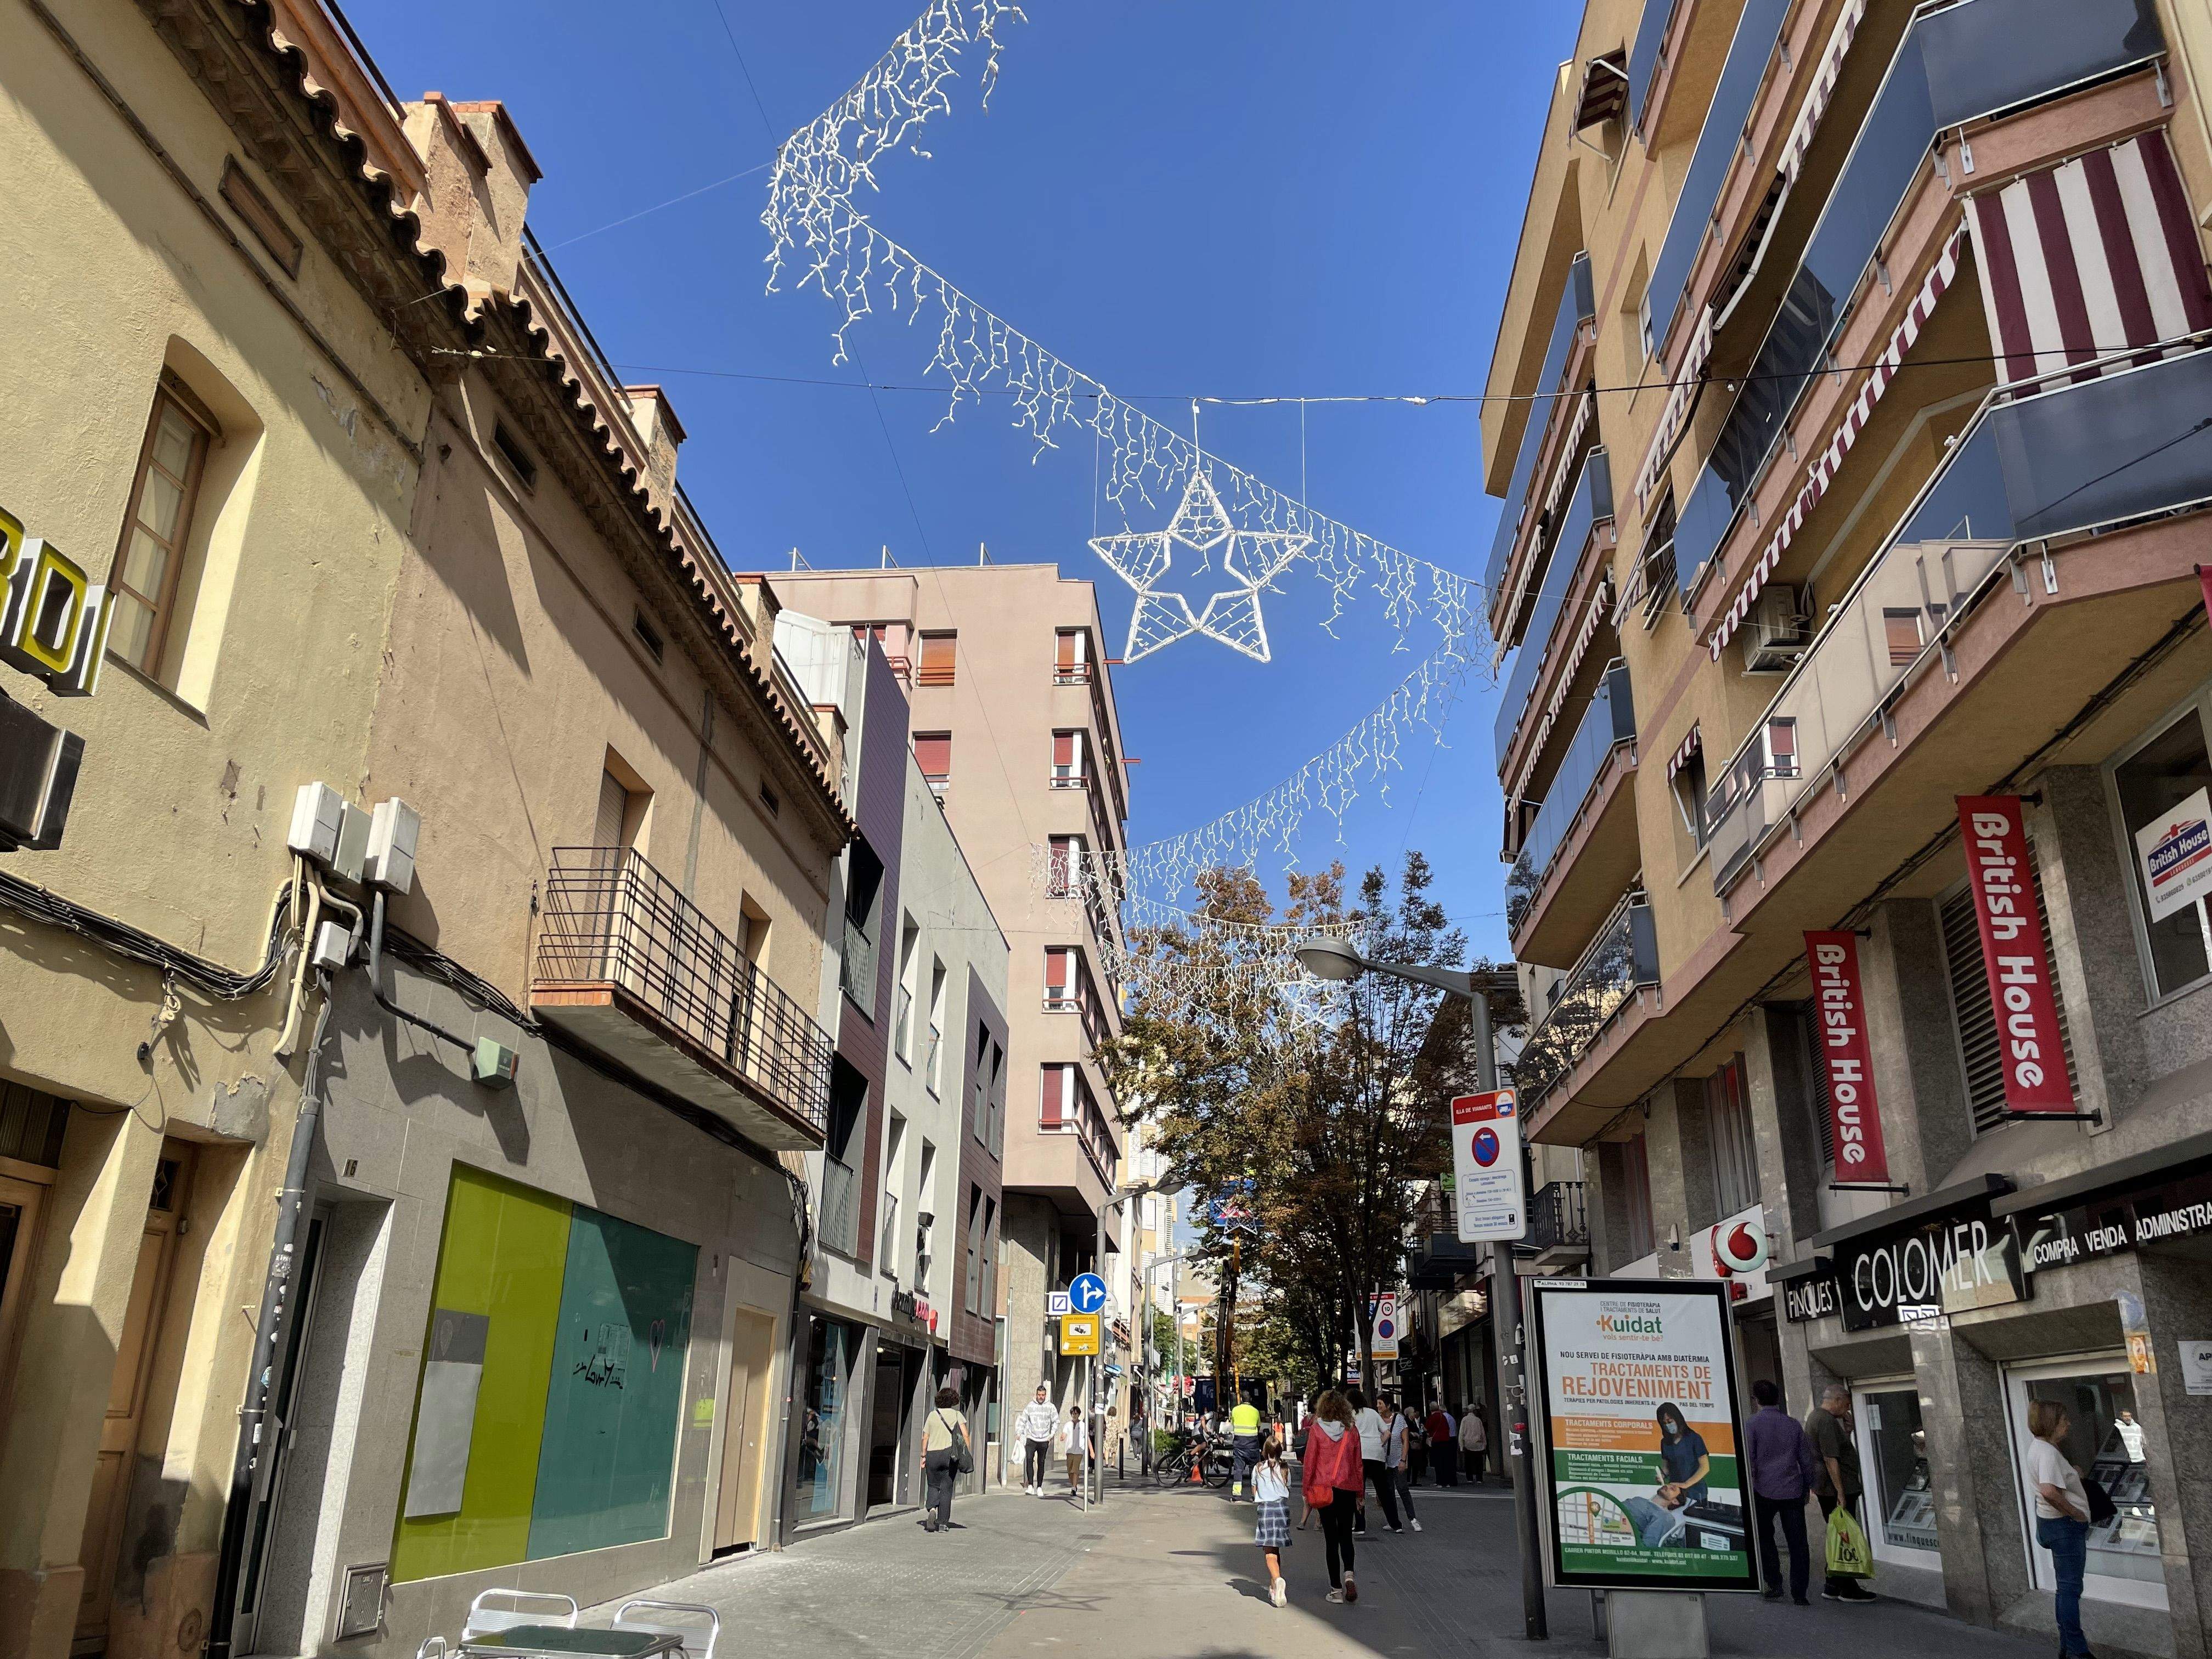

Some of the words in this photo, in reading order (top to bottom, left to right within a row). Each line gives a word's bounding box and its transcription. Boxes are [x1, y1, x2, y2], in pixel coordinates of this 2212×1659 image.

[2149, 845, 2179, 873] British
[2179, 829, 2208, 855] House
[1972, 813, 2027, 940] British
[1816, 944, 1857, 1047] British
[1997, 956, 2044, 1088] House
[1831, 1059, 1865, 1164] House
[346, 1159, 358, 1176] 16
[2034, 1236, 2080, 1264] COMPRA
[2085, 1224, 2128, 1252] VENDA
[1788, 1280, 1833, 1318] FINQUES
[1855, 1221, 1993, 1312] COLOMER
[1601, 1314, 1663, 1333] Kuidat
[1590, 1362, 1689, 1379] TRACTAMENTS
[1694, 1365, 1712, 1379] DE
[1611, 1352, 1655, 1361] FISIOTERÀPIA
[1674, 1354, 1709, 1363] DIATÈRMIA
[1562, 1376, 1712, 1400] REJOVENIMENT
[1565, 1419, 1612, 1427] TRACTAMENTS
[1567, 1453, 1615, 1462] TRACTAMENTS
